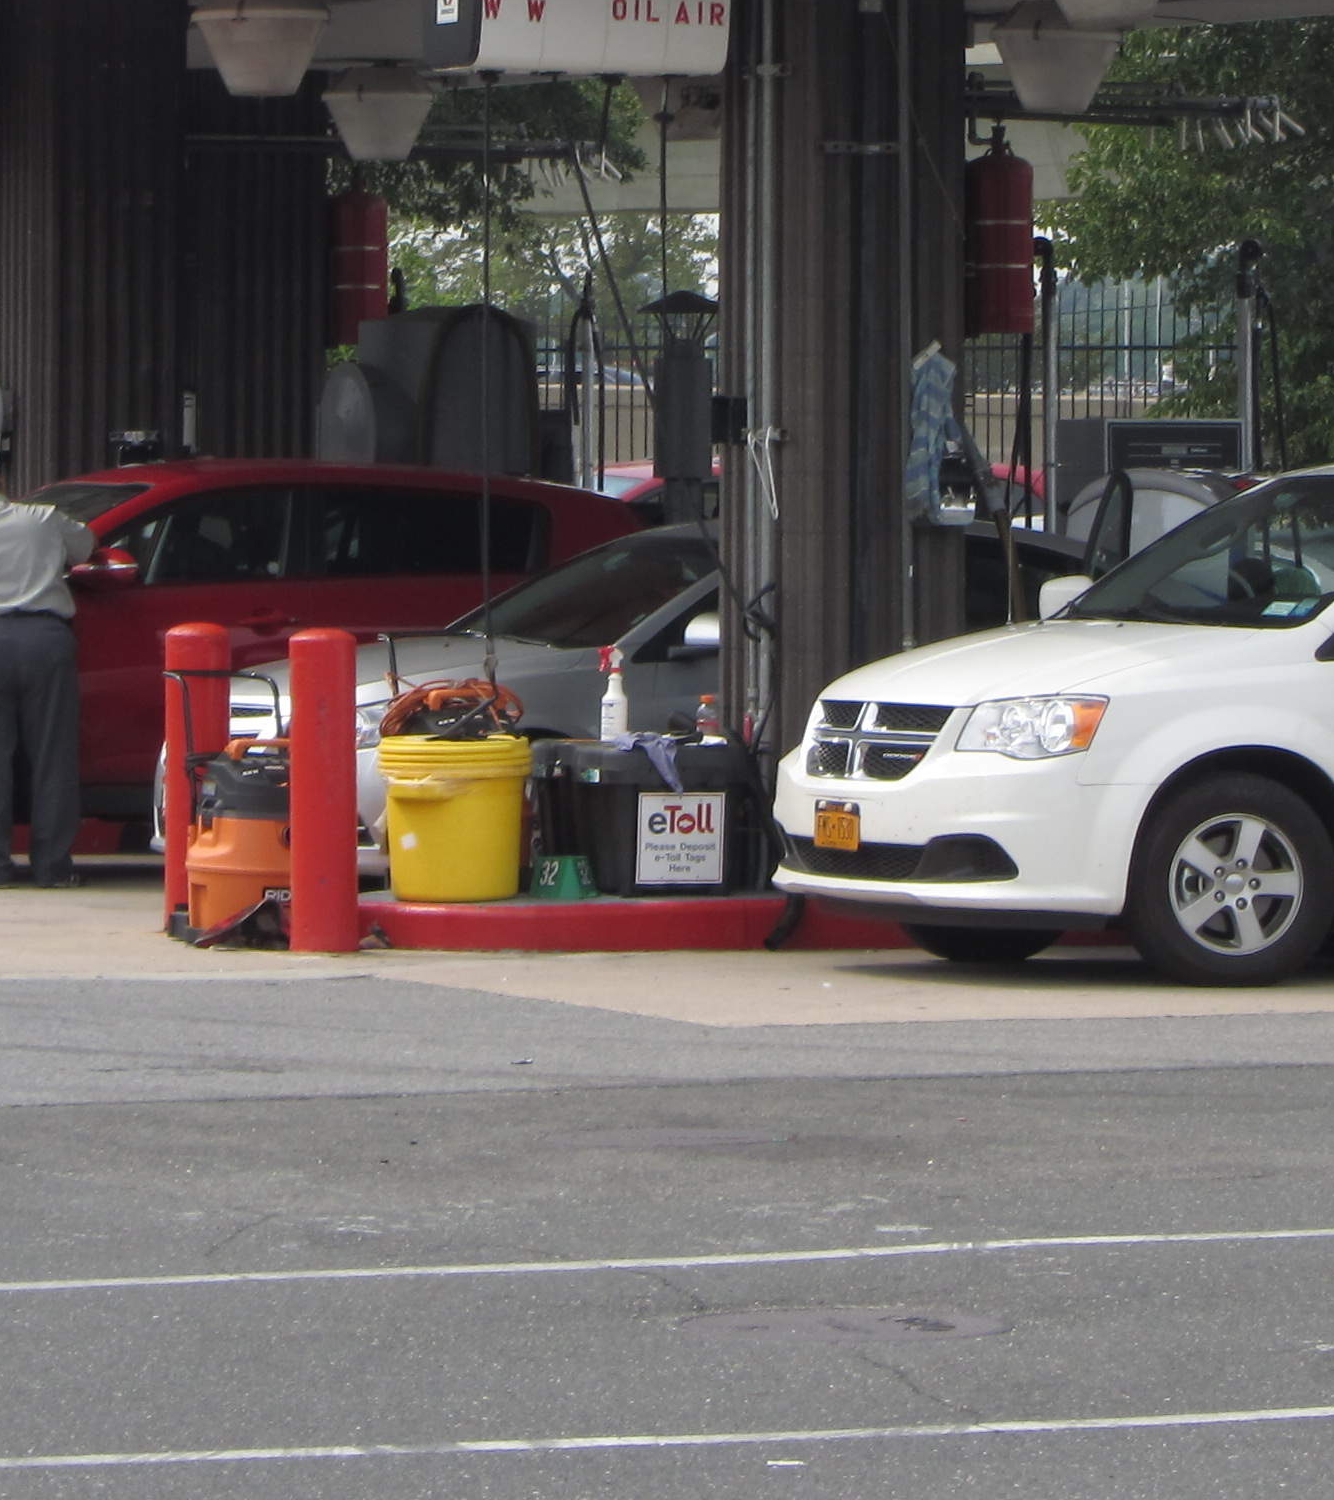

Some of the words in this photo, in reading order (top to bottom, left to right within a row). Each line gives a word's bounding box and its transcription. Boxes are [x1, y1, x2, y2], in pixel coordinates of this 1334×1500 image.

[674, 1, 725, 26] AIR
[648, 803, 714, 835] eToll
[644, 842, 676, 851] Please
[680, 842, 716, 852] Deposit
[685, 853, 707, 863] Tags
[540, 860, 560, 886] 32
[668, 864, 691, 872] Here
[264, 889, 291, 902] RID
